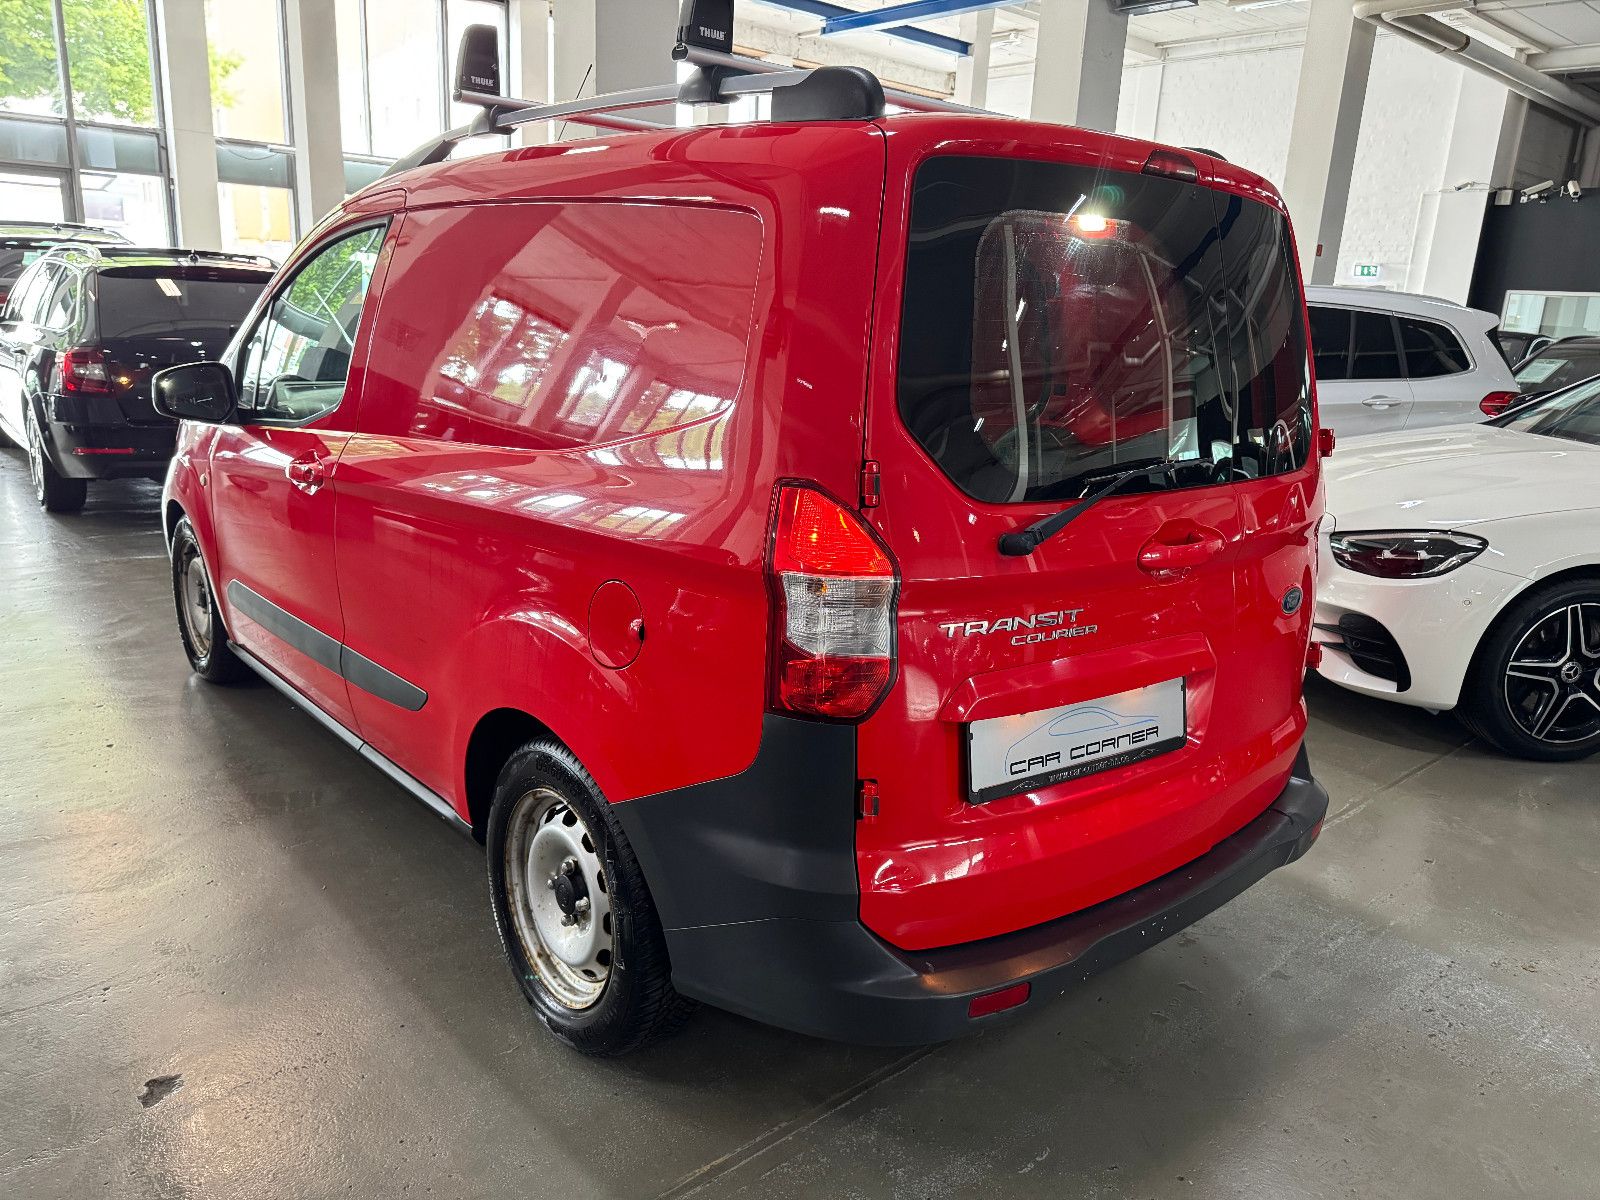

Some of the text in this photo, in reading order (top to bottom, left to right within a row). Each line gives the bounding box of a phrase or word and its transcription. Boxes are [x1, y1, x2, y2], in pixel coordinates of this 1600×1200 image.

[699, 26, 725, 41] THULE
[470, 75, 494, 87] THULE
[939, 608, 1084, 638] TRANSIT
[1011, 624, 1098, 646] COURIER
[1009, 725, 1159, 776] CAR CORNER
